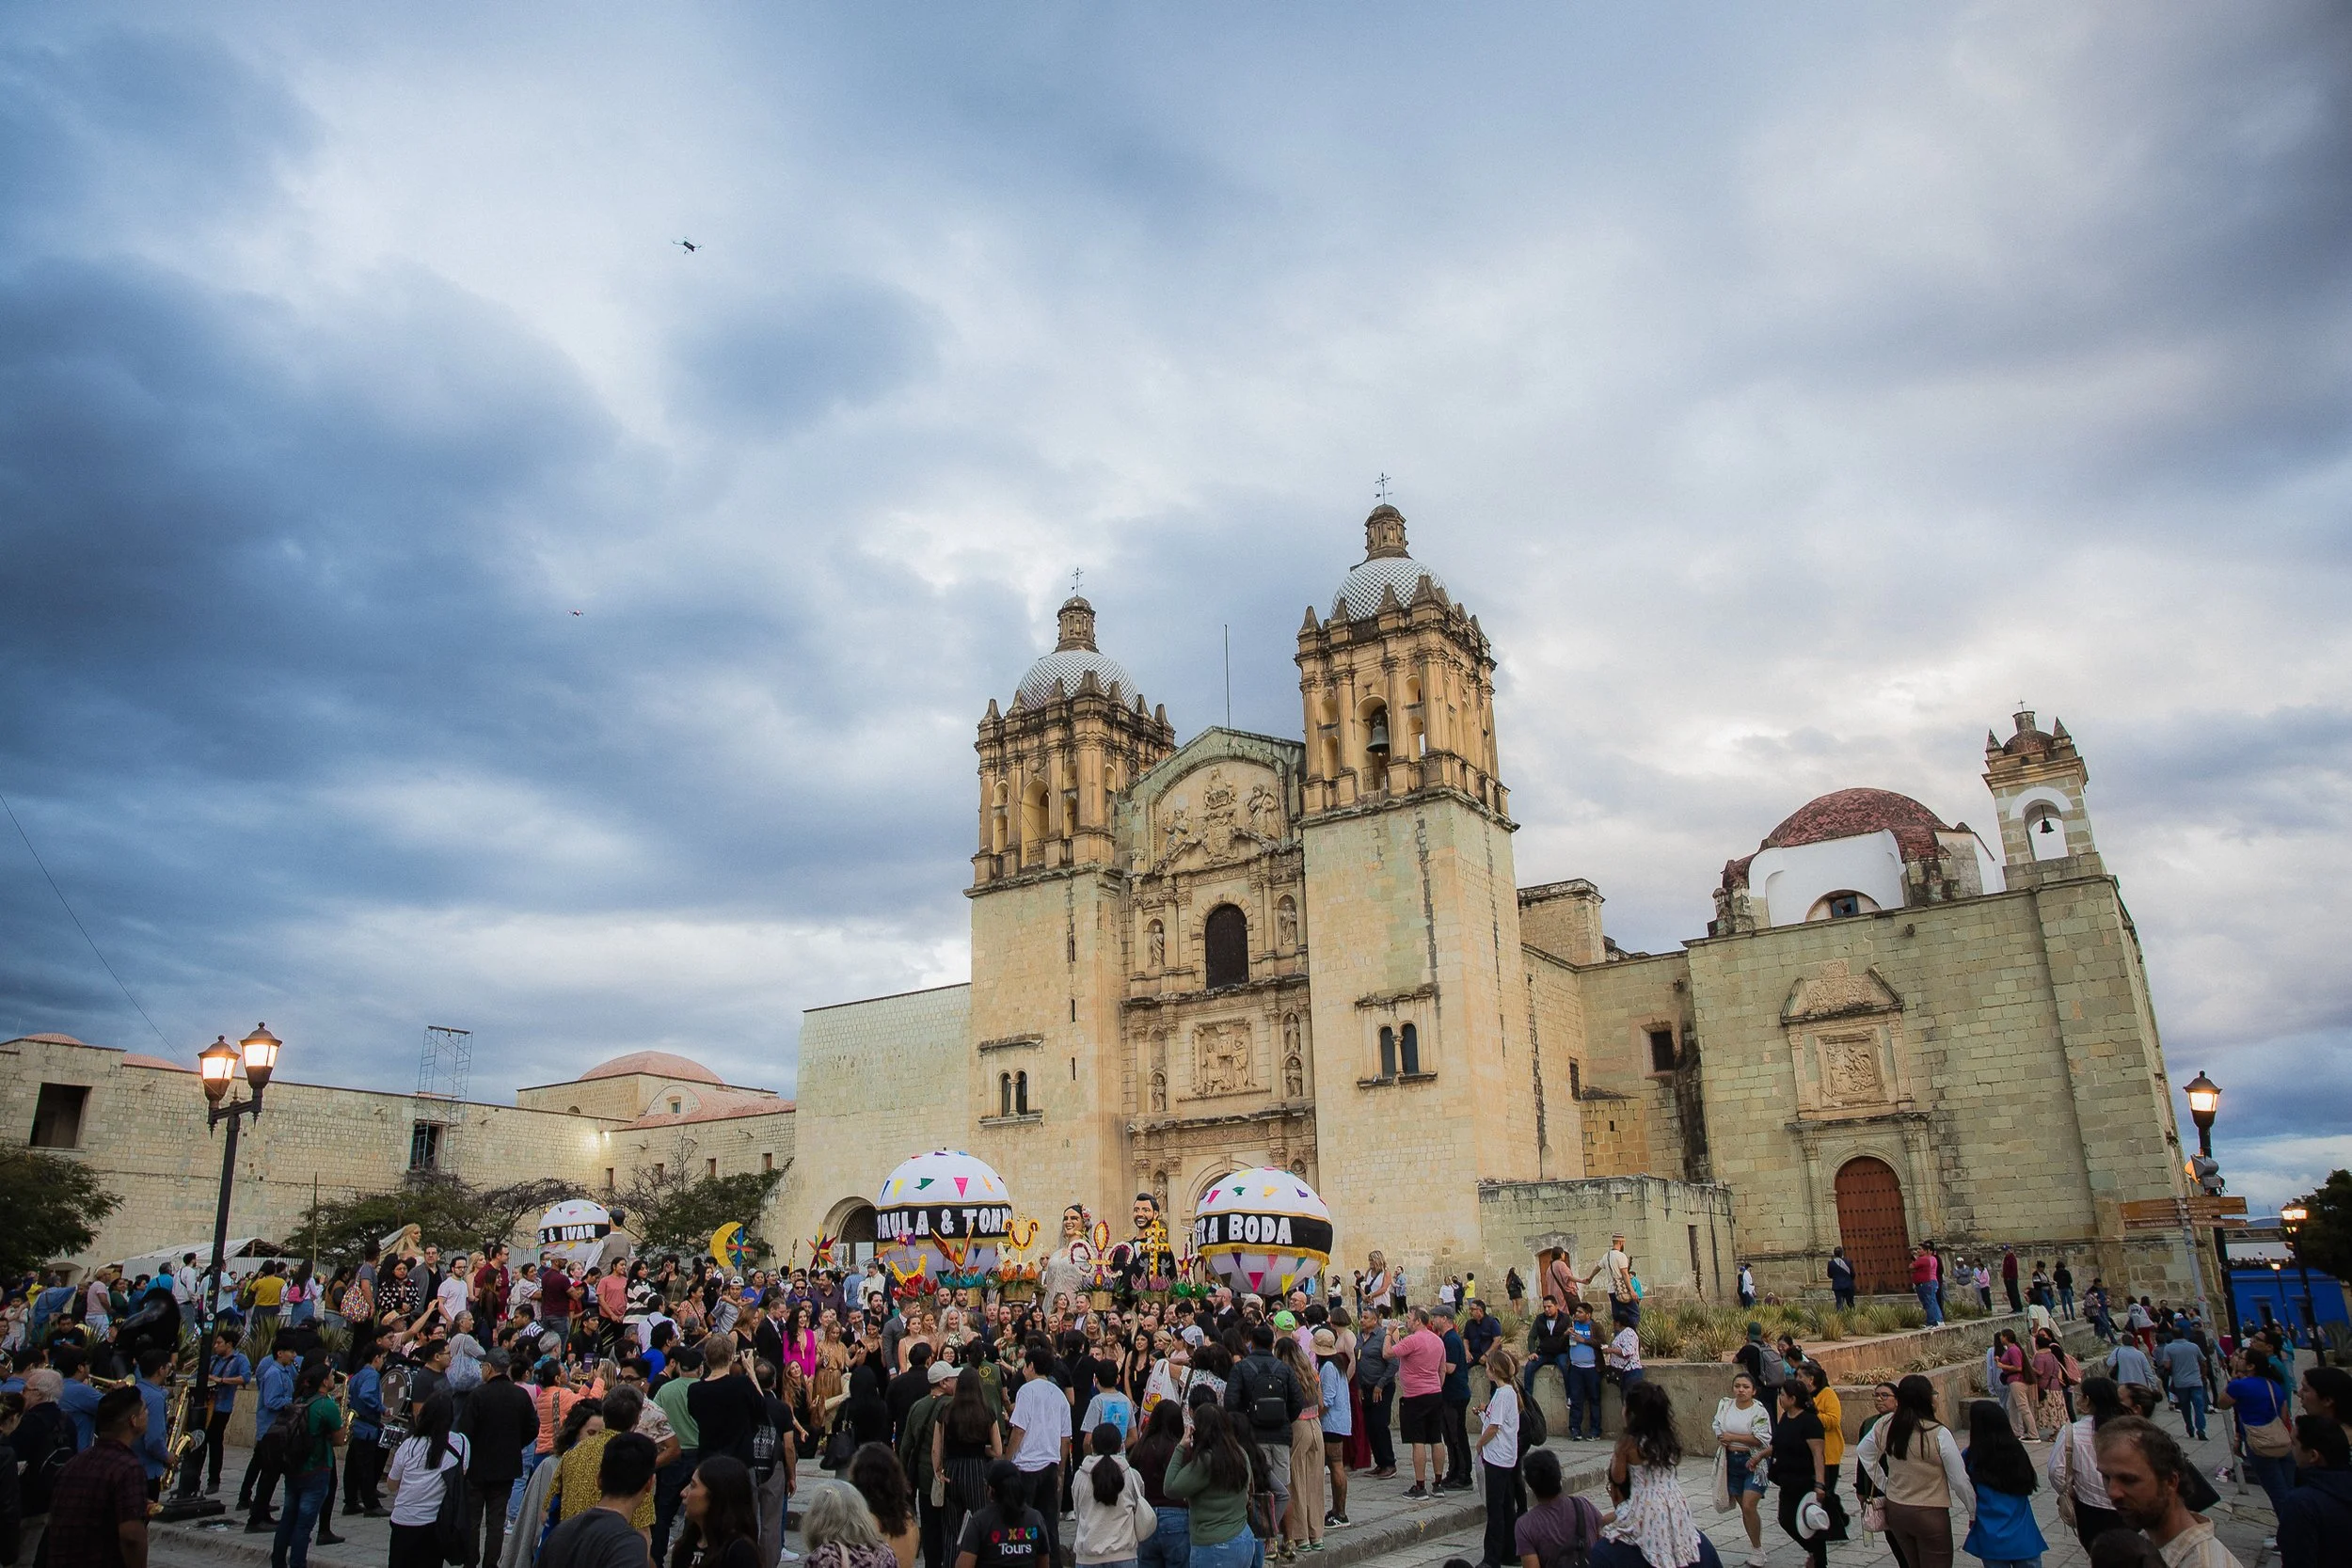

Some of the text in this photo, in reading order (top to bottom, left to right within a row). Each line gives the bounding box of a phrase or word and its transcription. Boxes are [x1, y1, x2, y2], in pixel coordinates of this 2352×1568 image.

[941, 1209, 954, 1235] &
[962, 1208, 1012, 1234] TOMM
[1229, 1214, 1293, 1244] BODA
[548, 1227, 556, 1242] &
[562, 1225, 595, 1241] IVAN
[998, 1543, 1032, 1555] Tours
